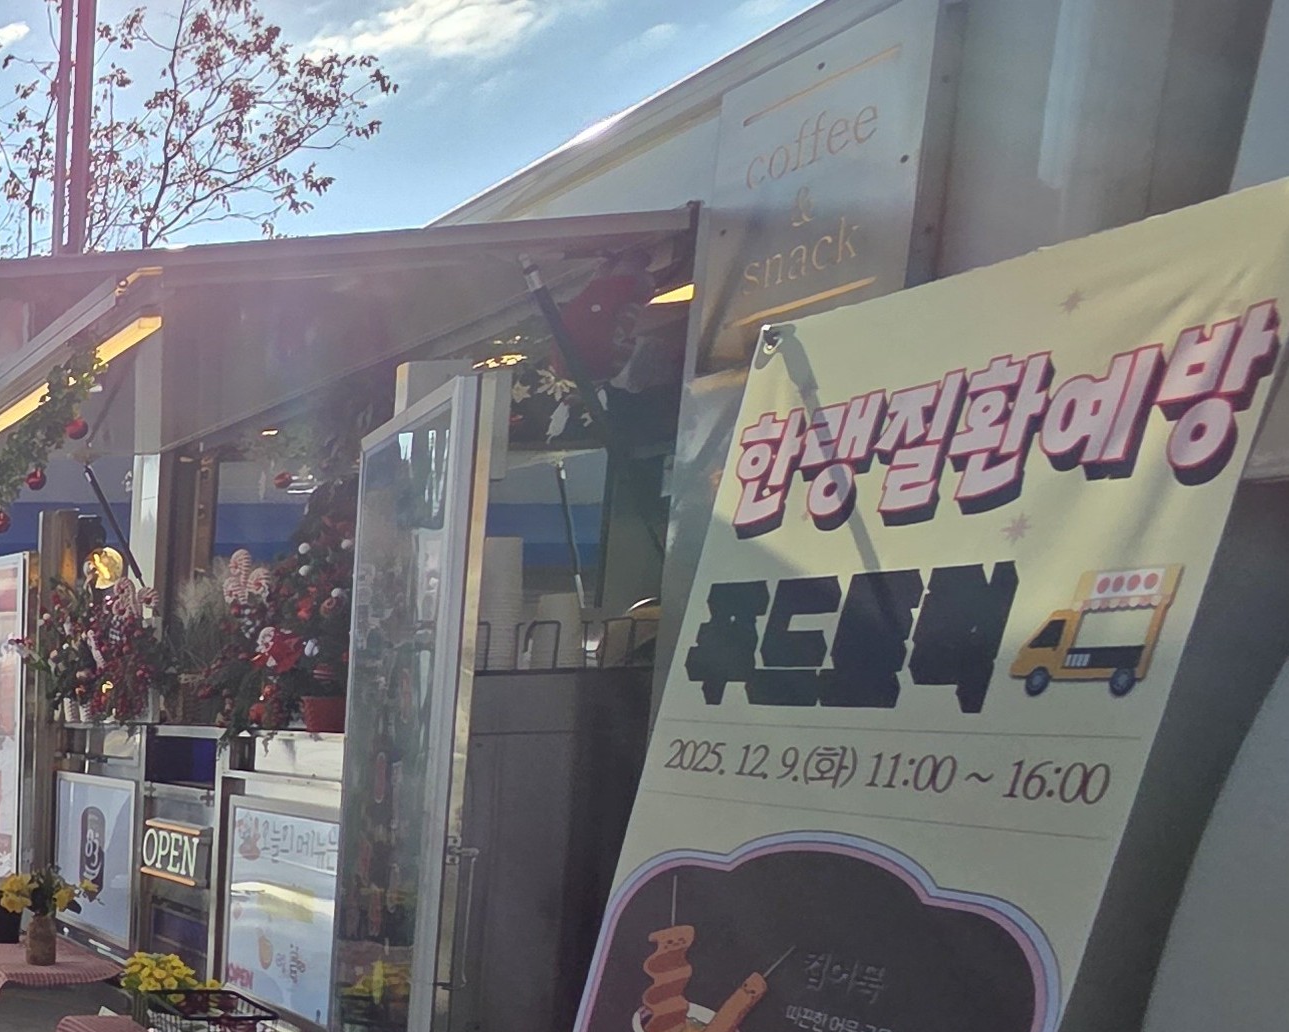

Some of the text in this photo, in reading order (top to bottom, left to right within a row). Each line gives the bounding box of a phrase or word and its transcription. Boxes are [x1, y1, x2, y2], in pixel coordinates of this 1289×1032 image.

[746, 105, 879, 190] coffee
[742, 216, 862, 295] snack
[663, 738, 726, 776] 2025.
[735, 743, 769, 780] 12.
[865, 752, 958, 794] 11:00
[1002, 759, 1112, 805] 16:00
[142, 828, 200, 878] OPEN
[785, 1004, 829, 1032] 따끈한
